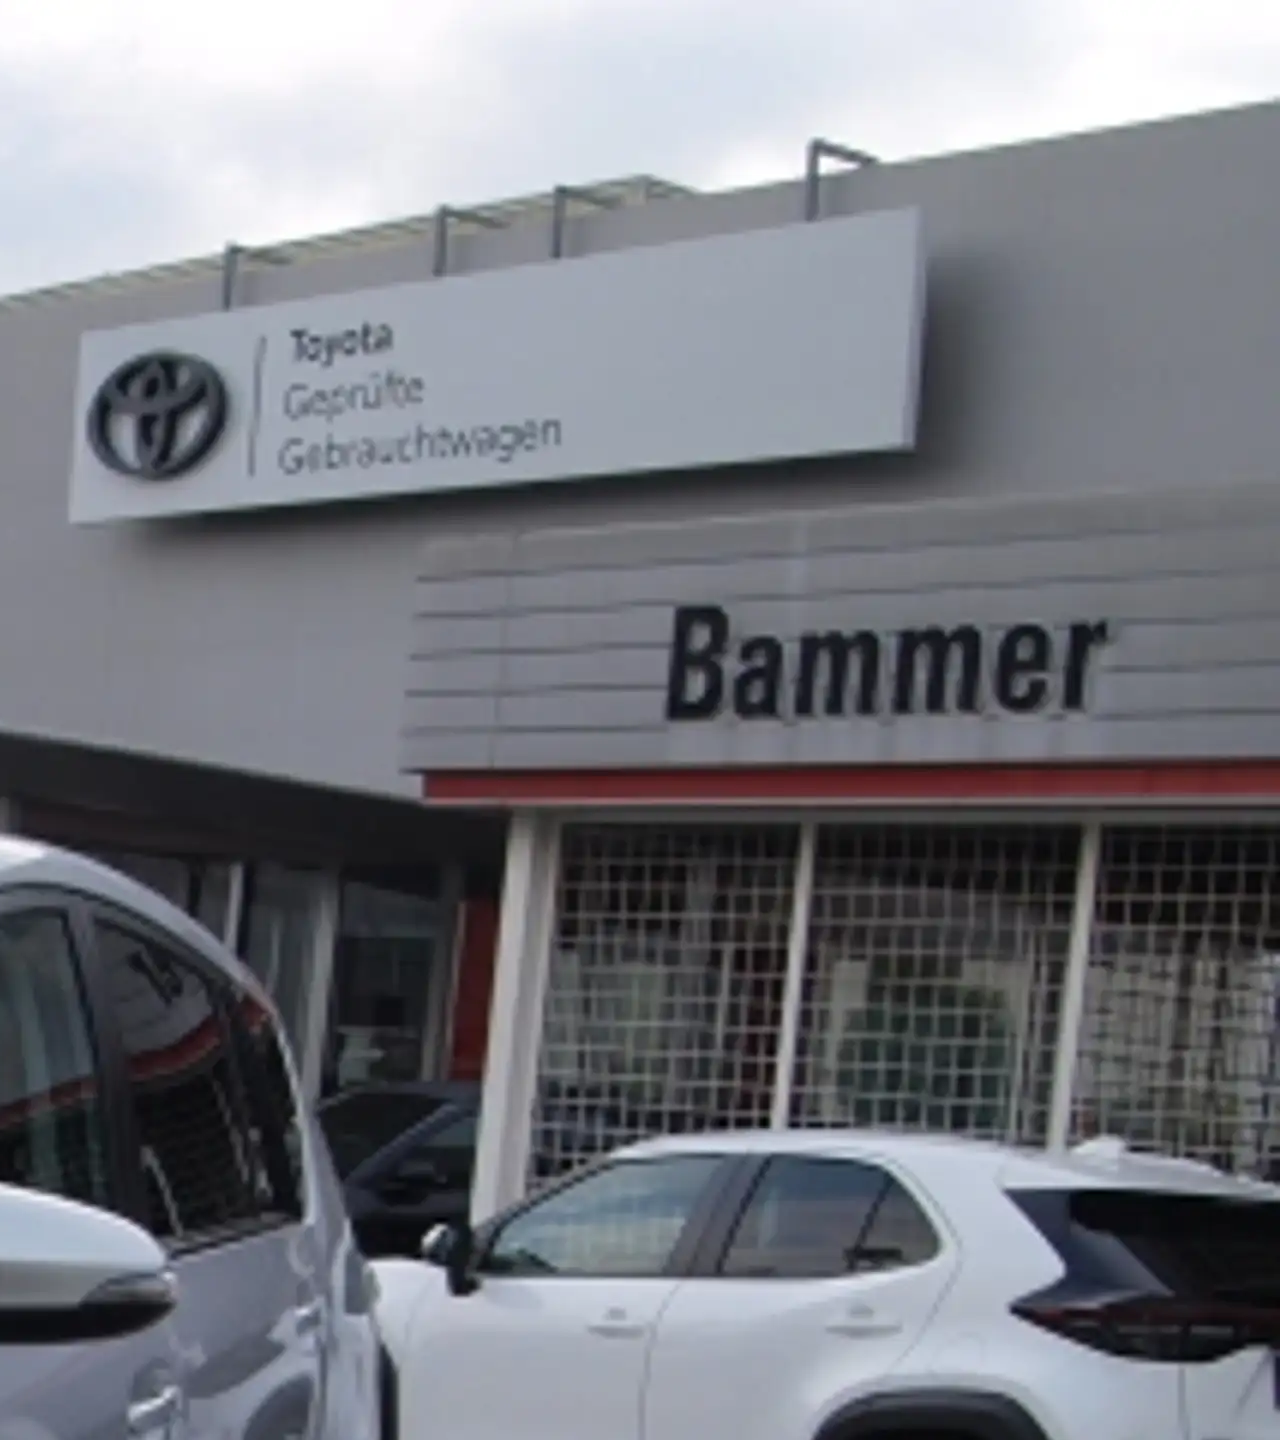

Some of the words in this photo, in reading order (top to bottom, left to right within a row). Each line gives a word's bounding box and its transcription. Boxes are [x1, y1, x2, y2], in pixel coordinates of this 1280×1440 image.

[288, 321, 394, 367] Toyota
[282, 370, 425, 421] Geprüfte
[278, 416, 563, 476] Gebrauchtwagen
[667, 603, 1109, 721] Bammer
